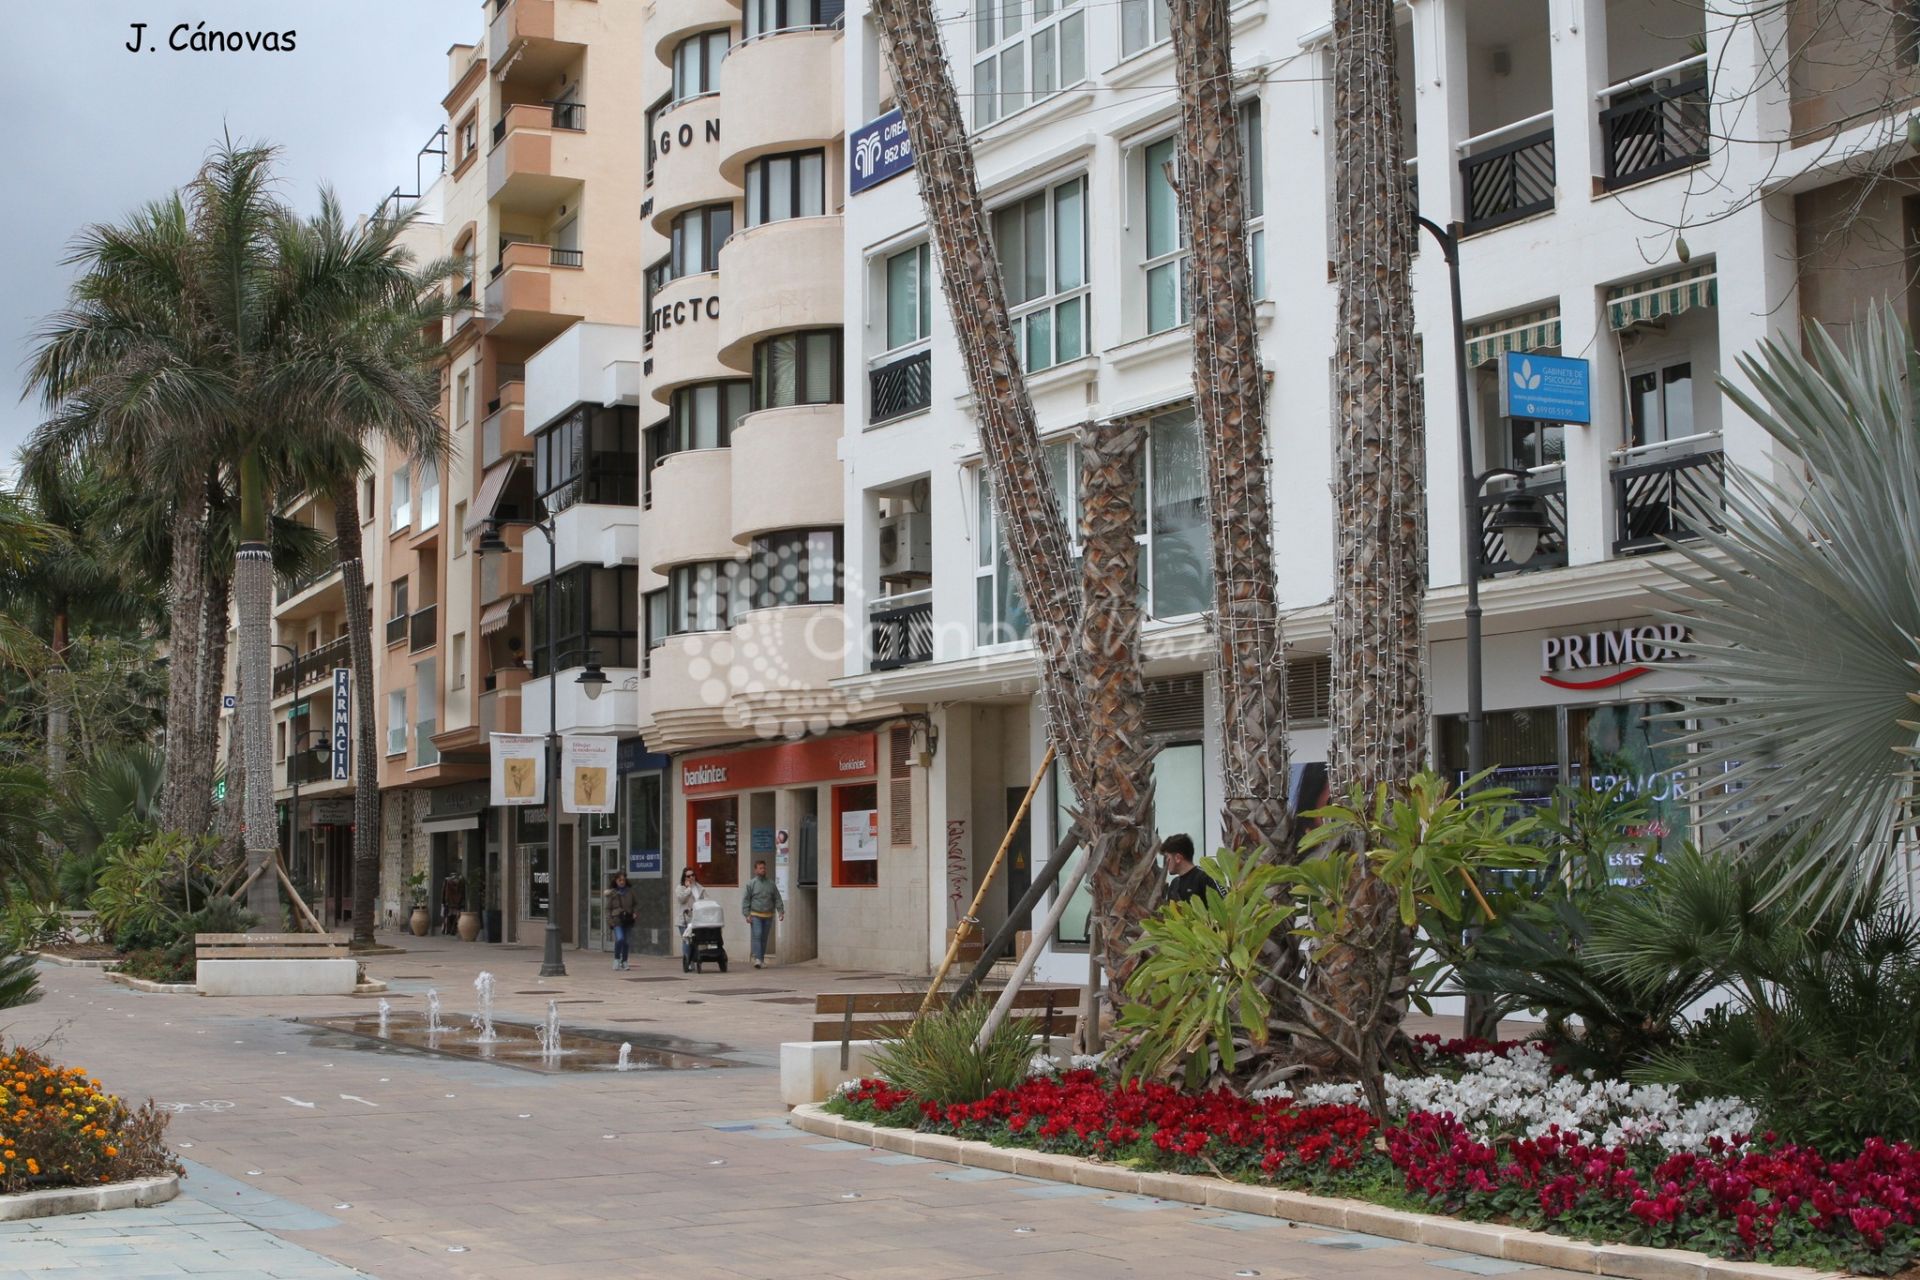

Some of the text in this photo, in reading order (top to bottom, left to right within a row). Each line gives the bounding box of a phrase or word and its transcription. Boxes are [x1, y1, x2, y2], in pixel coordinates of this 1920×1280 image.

[884, 144, 900, 165] 952
[1541, 622, 1692, 672] PRIMOR
[336, 671, 348, 778] FARMACIA
